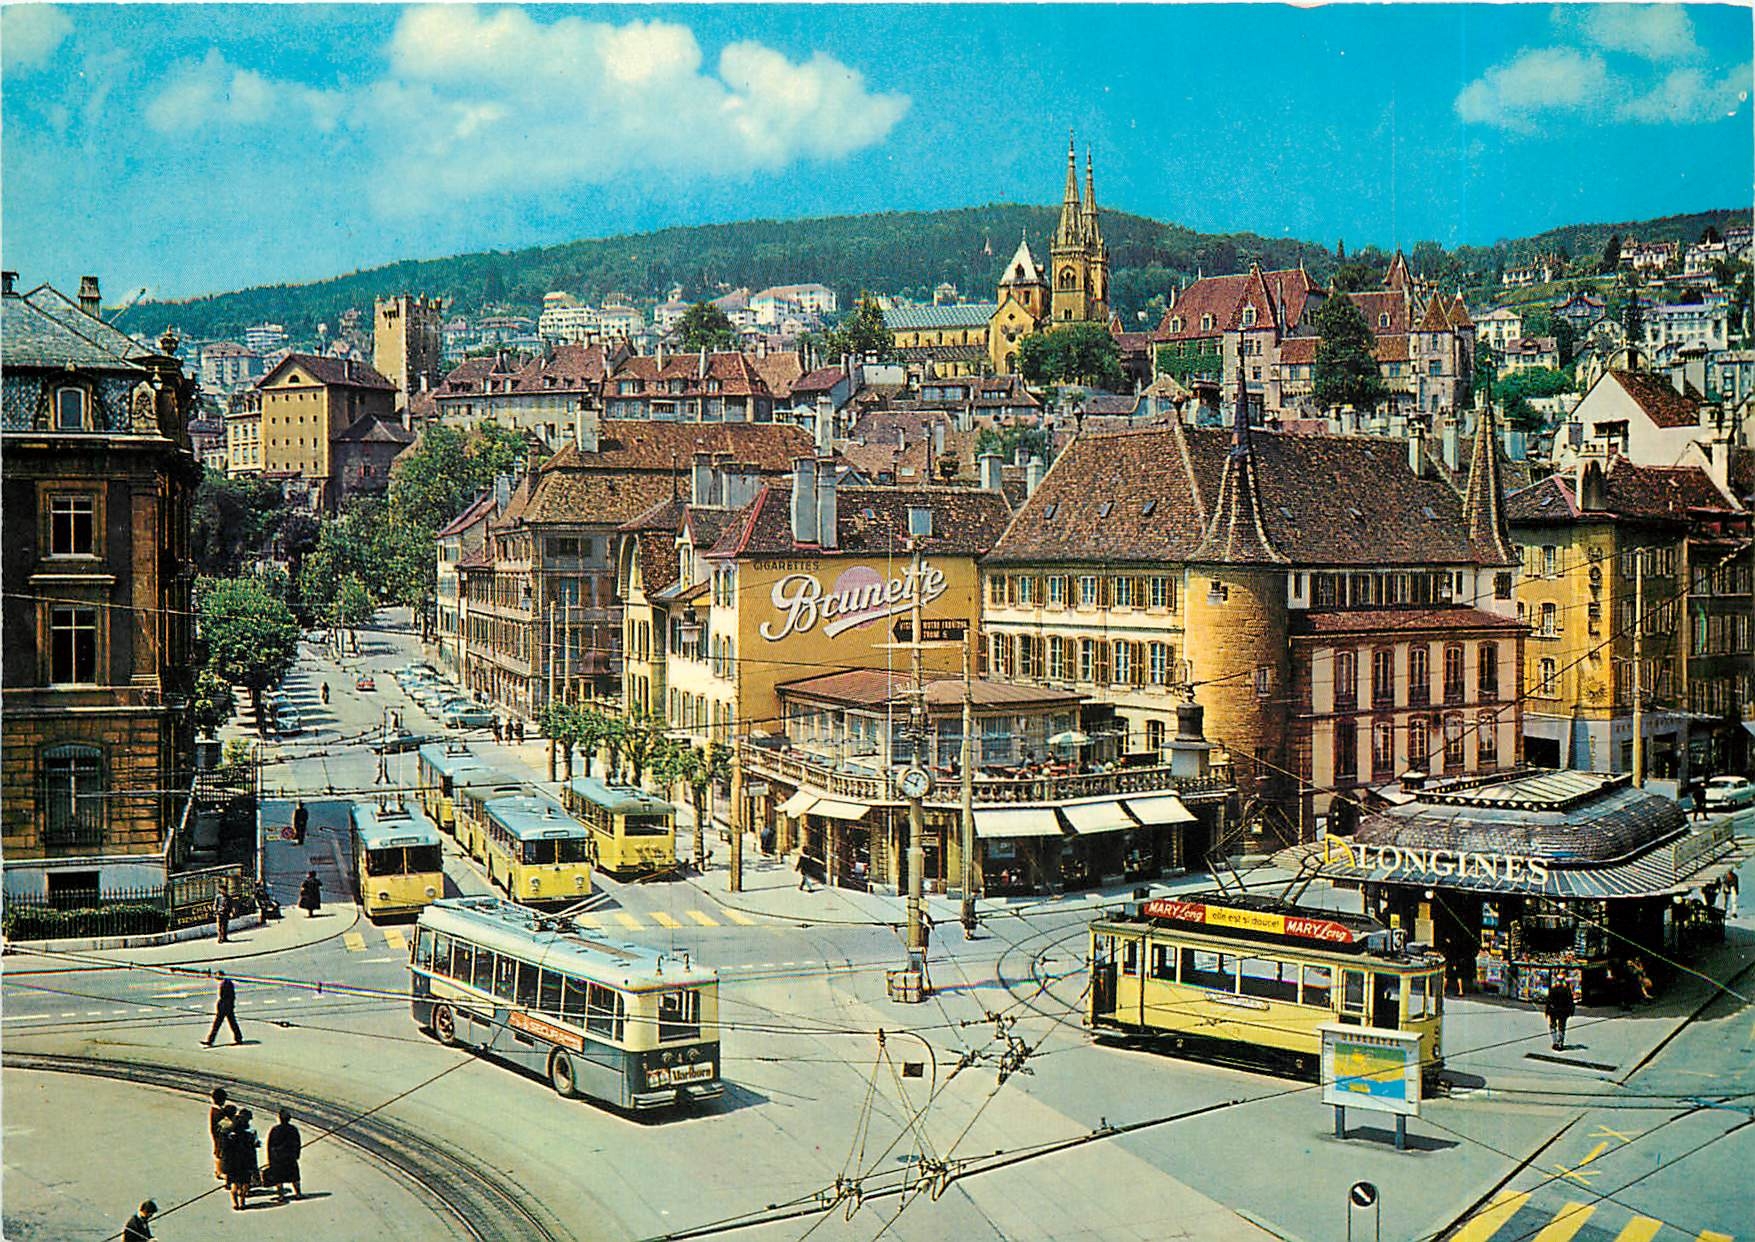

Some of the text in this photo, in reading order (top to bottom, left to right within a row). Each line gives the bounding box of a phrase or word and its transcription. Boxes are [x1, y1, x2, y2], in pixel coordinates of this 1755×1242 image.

[753, 561, 819, 571] CIGARETTES
[759, 561, 949, 641] Brunette
[1356, 843, 1550, 886] LONGINES
[1148, 901, 1205, 923] MARY Long
[1212, 909, 1228, 921] elle
[1228, 913, 1242, 923] est
[1286, 921, 1347, 942] MARY Long
